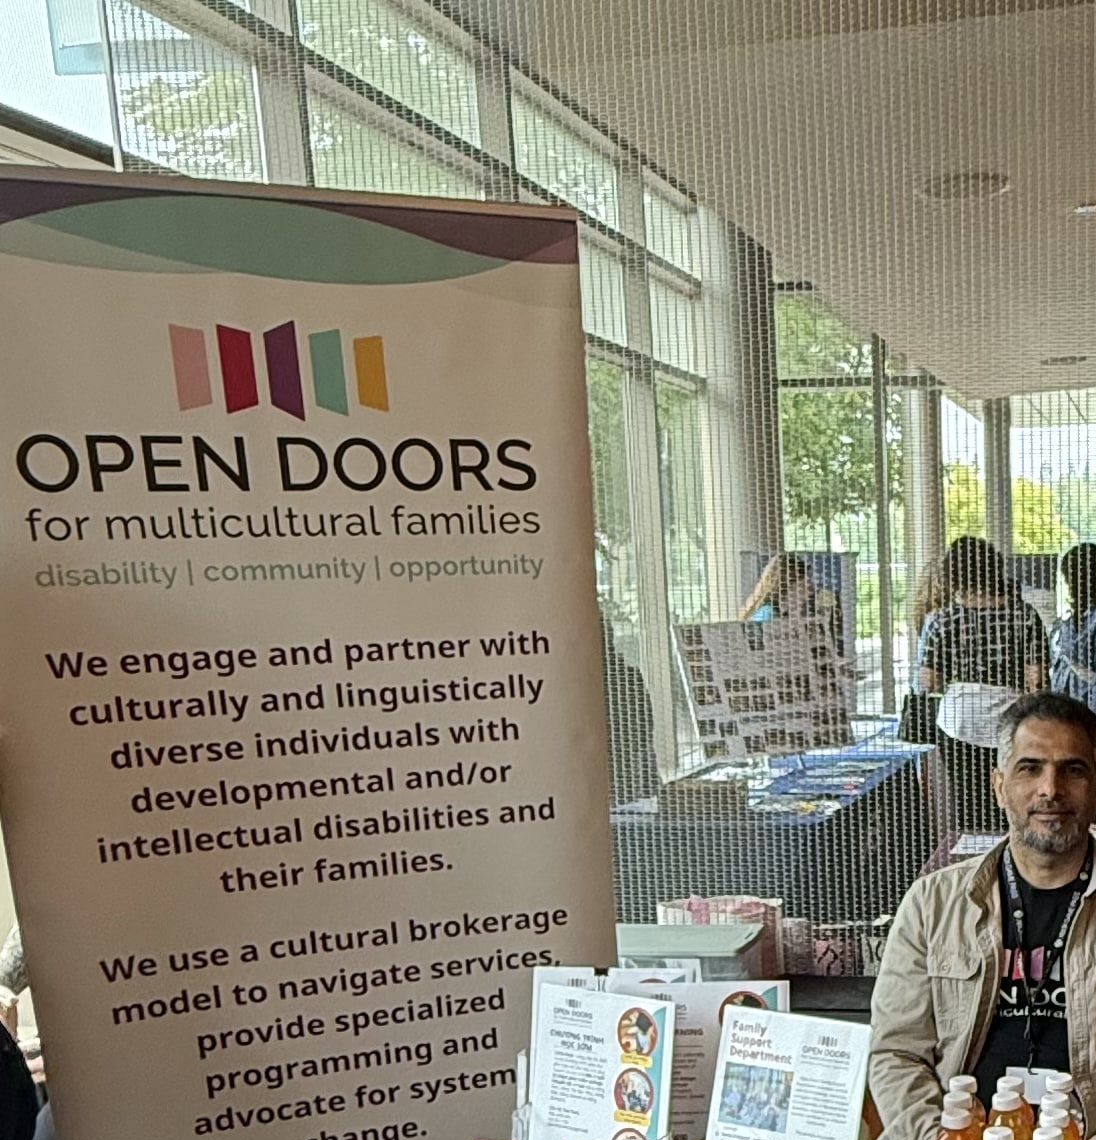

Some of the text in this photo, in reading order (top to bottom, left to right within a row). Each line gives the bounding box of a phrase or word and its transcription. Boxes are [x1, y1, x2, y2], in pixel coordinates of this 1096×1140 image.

[16, 433, 538, 493] OPEN DOORS
[25, 504, 542, 542] for multicultural families
[35, 560, 177, 589] disability
[203, 556, 366, 586] community
[389, 553, 544, 582] opportunity
[46, 630, 550, 680] We engage and partner with
[69, 674, 544, 727] culturally and linguistically
[109, 717, 520, 770] diverse individuals with
[130, 761, 513, 815] developmental and/or
[97, 797, 556, 864] intellectual disabilities and
[220, 850, 453, 893] their families.
[99, 905, 569, 983] We use a cultural brokerage
[111, 947, 561, 1025] model to navigate services,
[196, 989, 506, 1059] provide specialized
[730, 1033, 772, 1050] Support
[733, 1020, 767, 1037] Family
[205, 1029, 499, 1098] programming and
[730, 1046, 793, 1066] Department
[194, 1093, 346, 1136] advocate
[355, 1085, 401, 1109] for
[409, 1066, 516, 1102] system
